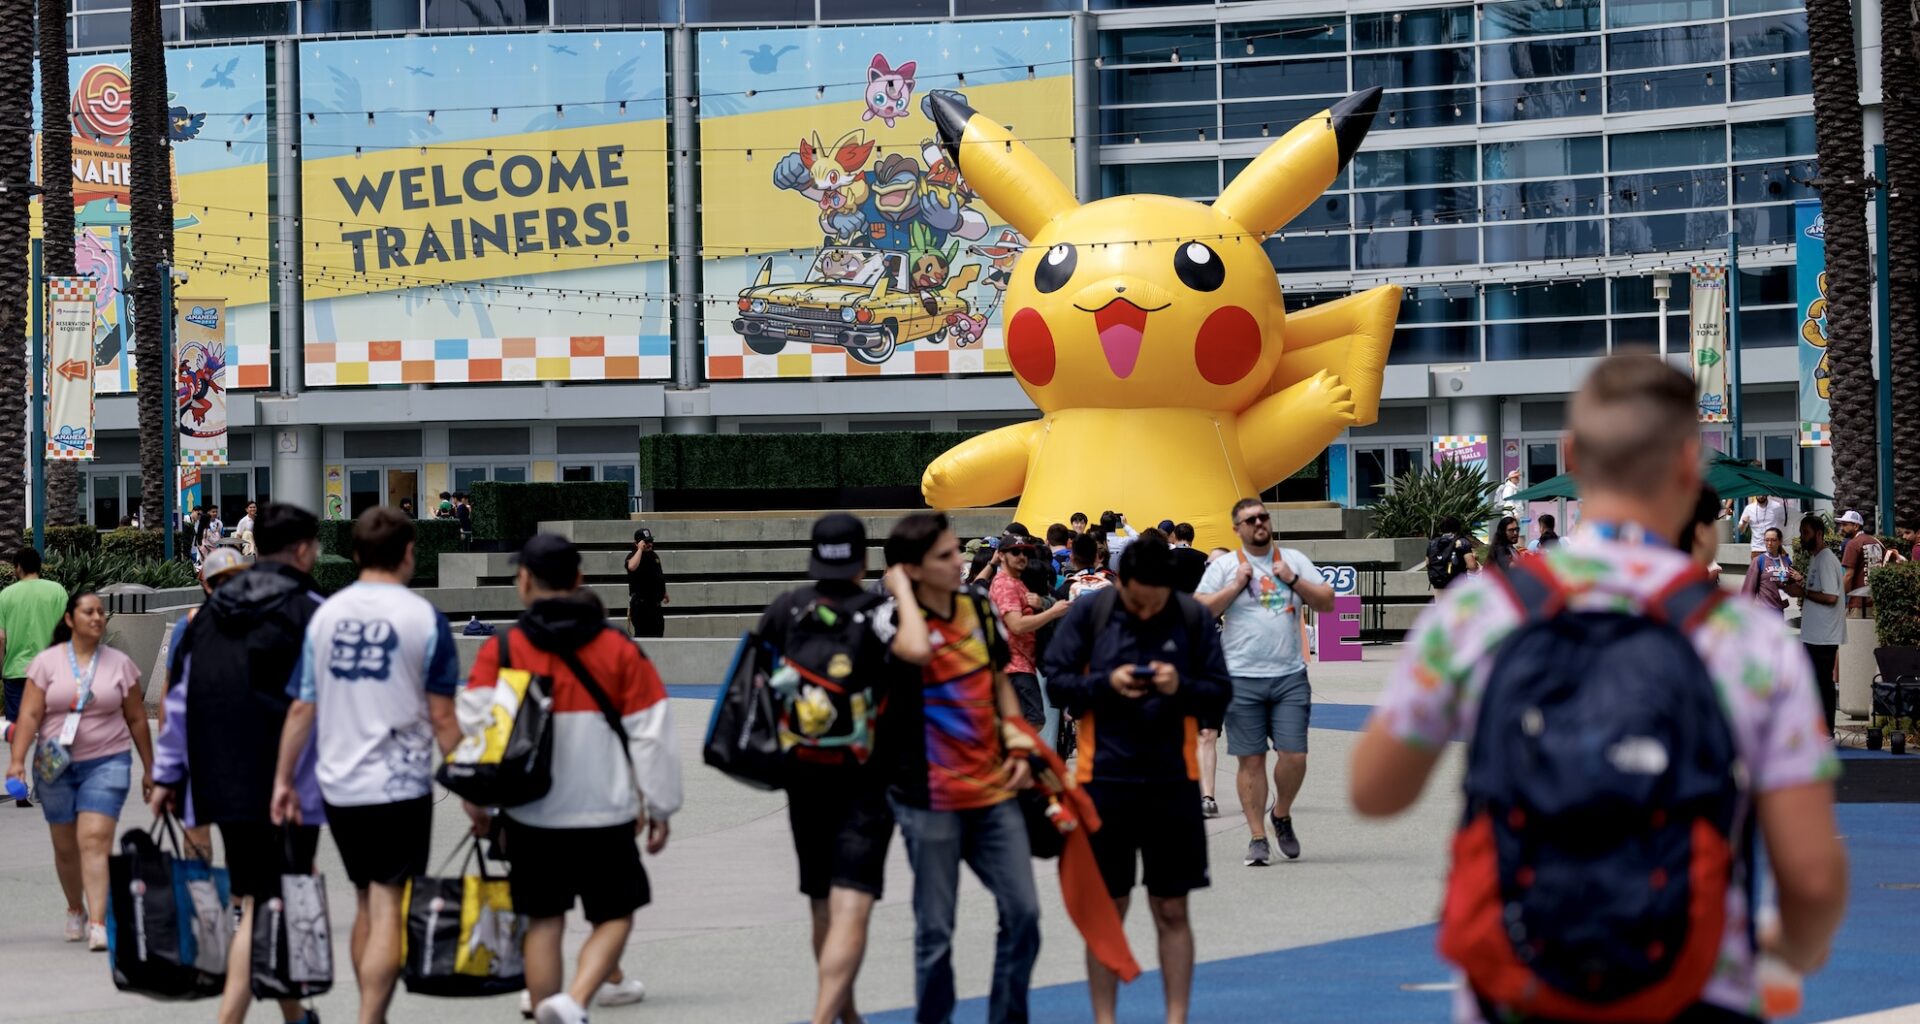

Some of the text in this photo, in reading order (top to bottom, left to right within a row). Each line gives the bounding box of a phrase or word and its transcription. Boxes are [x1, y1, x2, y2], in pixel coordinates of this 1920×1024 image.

[72, 158, 130, 185] NAHE
[333, 144, 629, 217] WELCOME
[341, 200, 630, 272] TRAINERS!
[1462, 451, 1481, 460] HALLS
